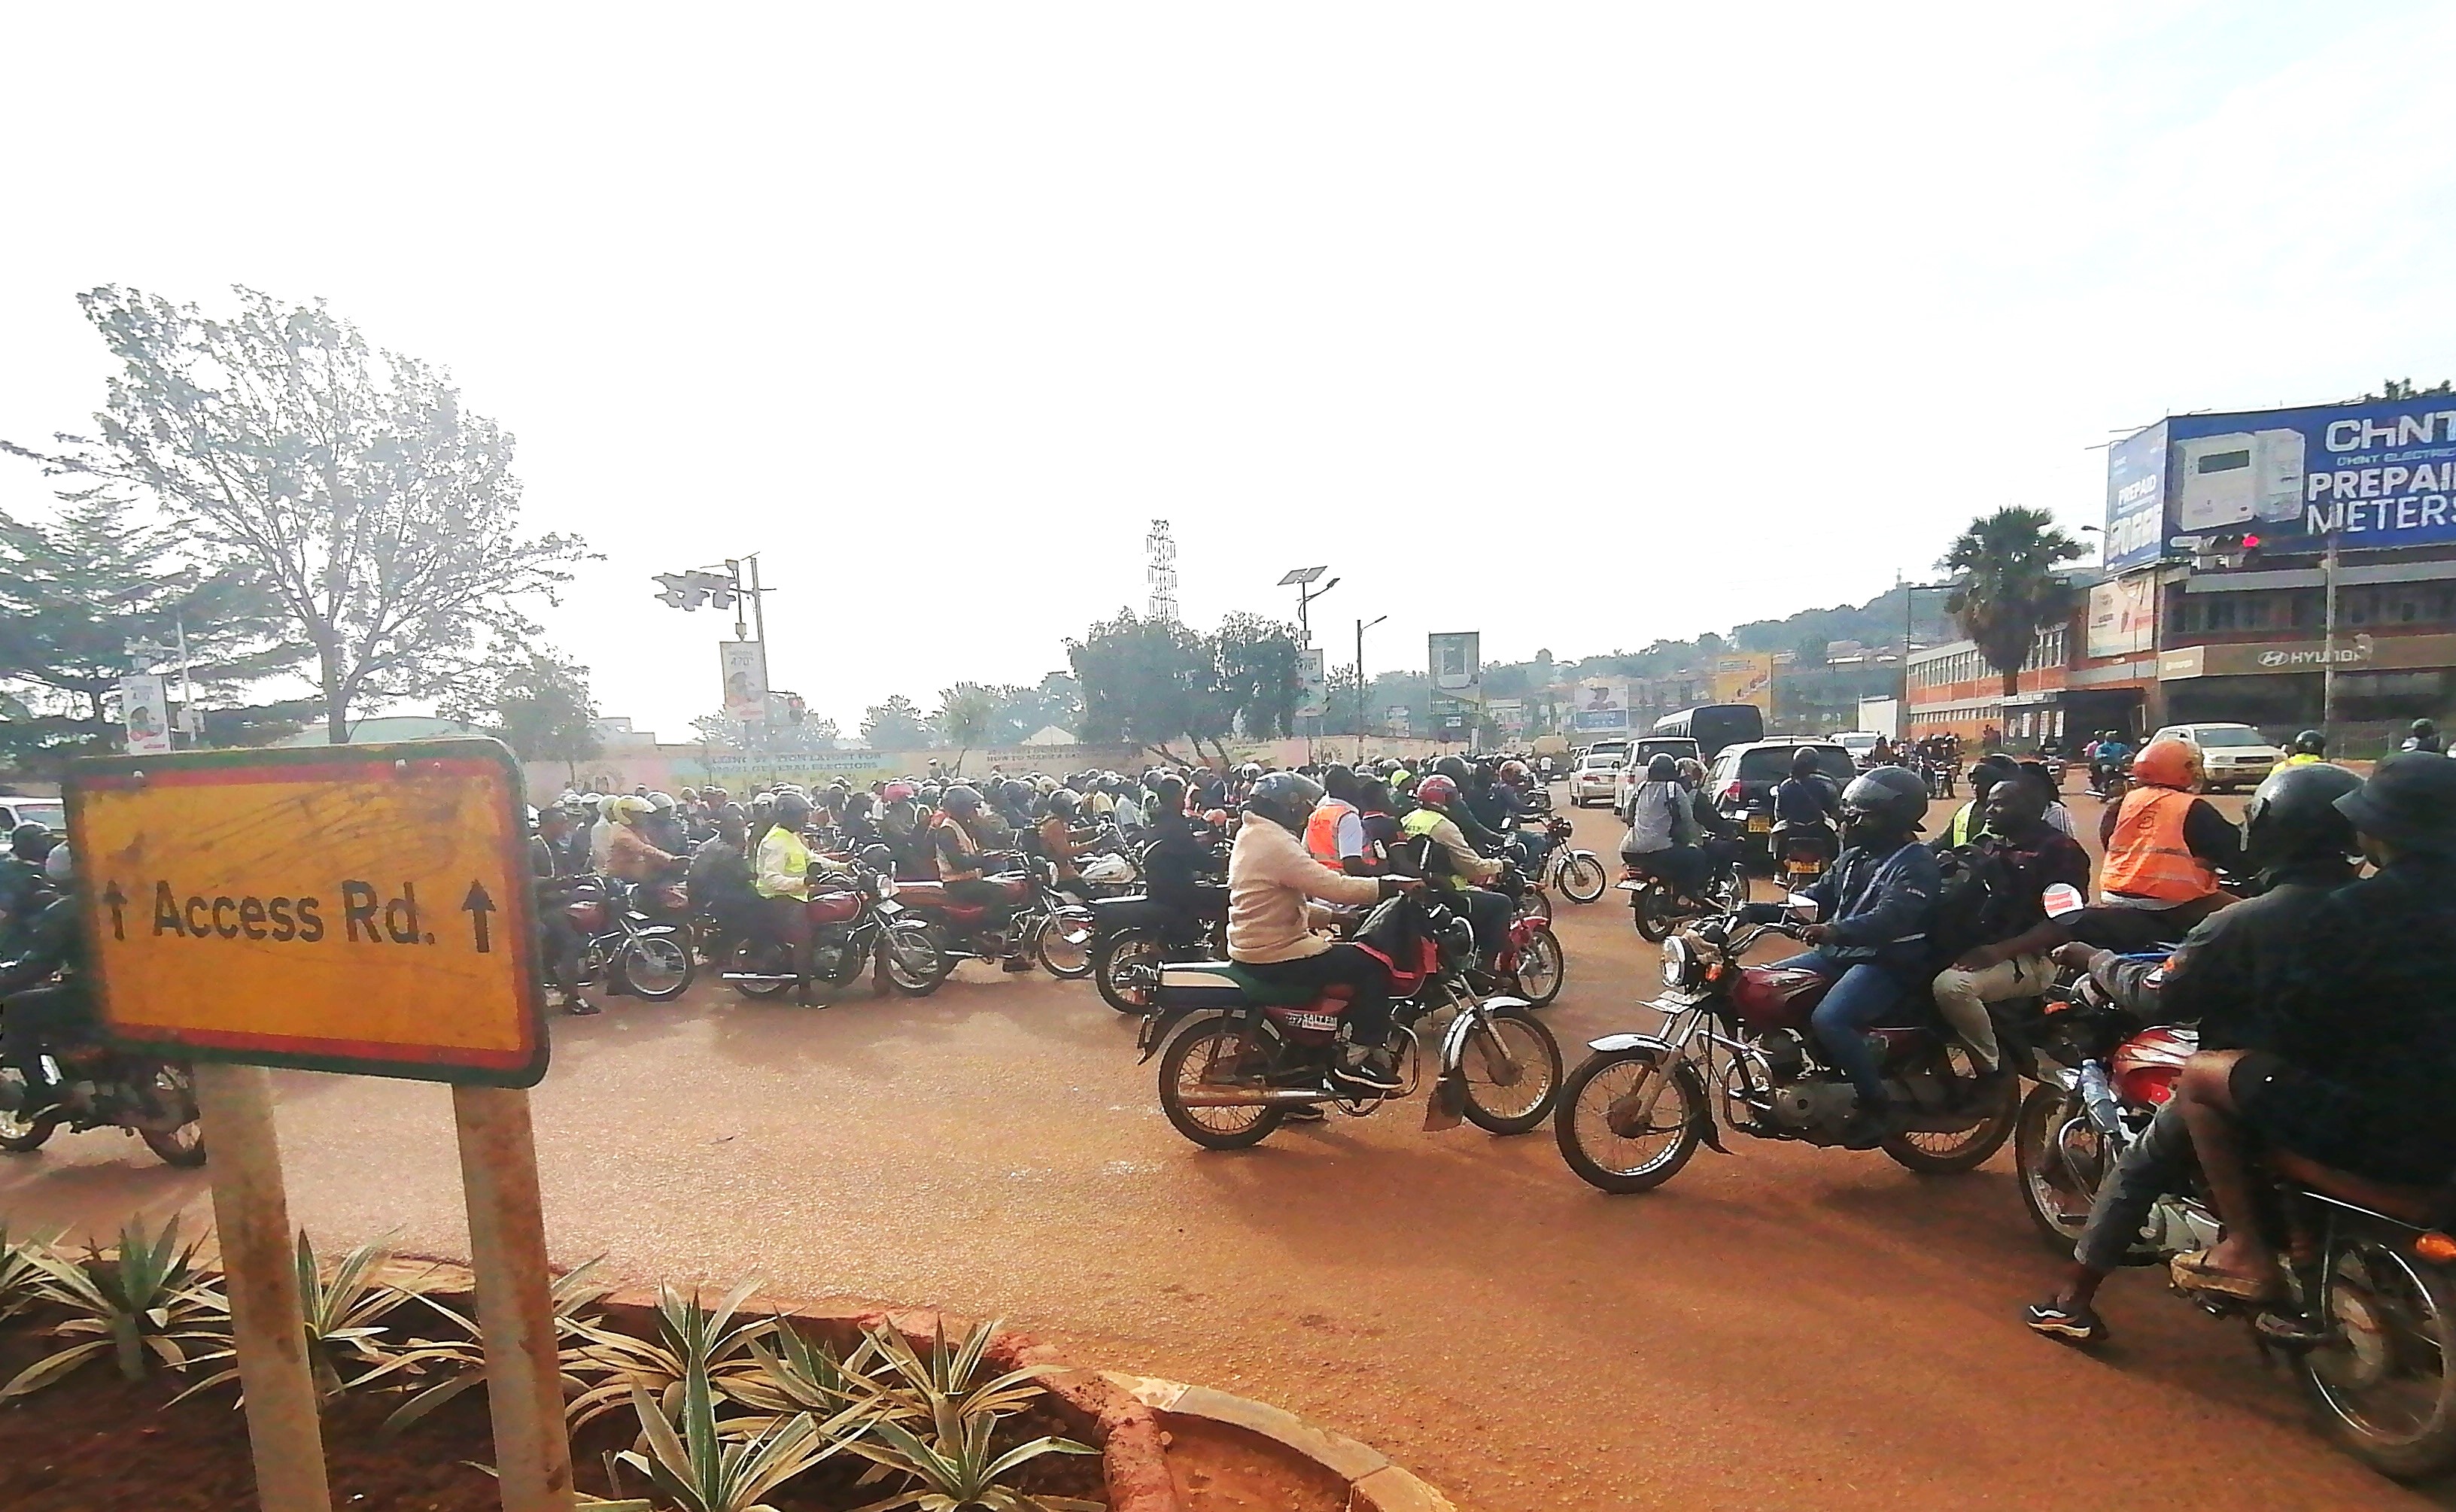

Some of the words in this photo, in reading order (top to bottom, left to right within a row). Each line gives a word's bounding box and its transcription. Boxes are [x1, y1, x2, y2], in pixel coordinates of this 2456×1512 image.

[2118, 474, 2157, 506] PREPAID
[2308, 461, 2456, 502] PREPAI
[2307, 493, 2456, 535] METER
[812, 761, 878, 770] ELECTIONS
[153, 879, 324, 943] Access
[342, 879, 436, 946] Rd.
